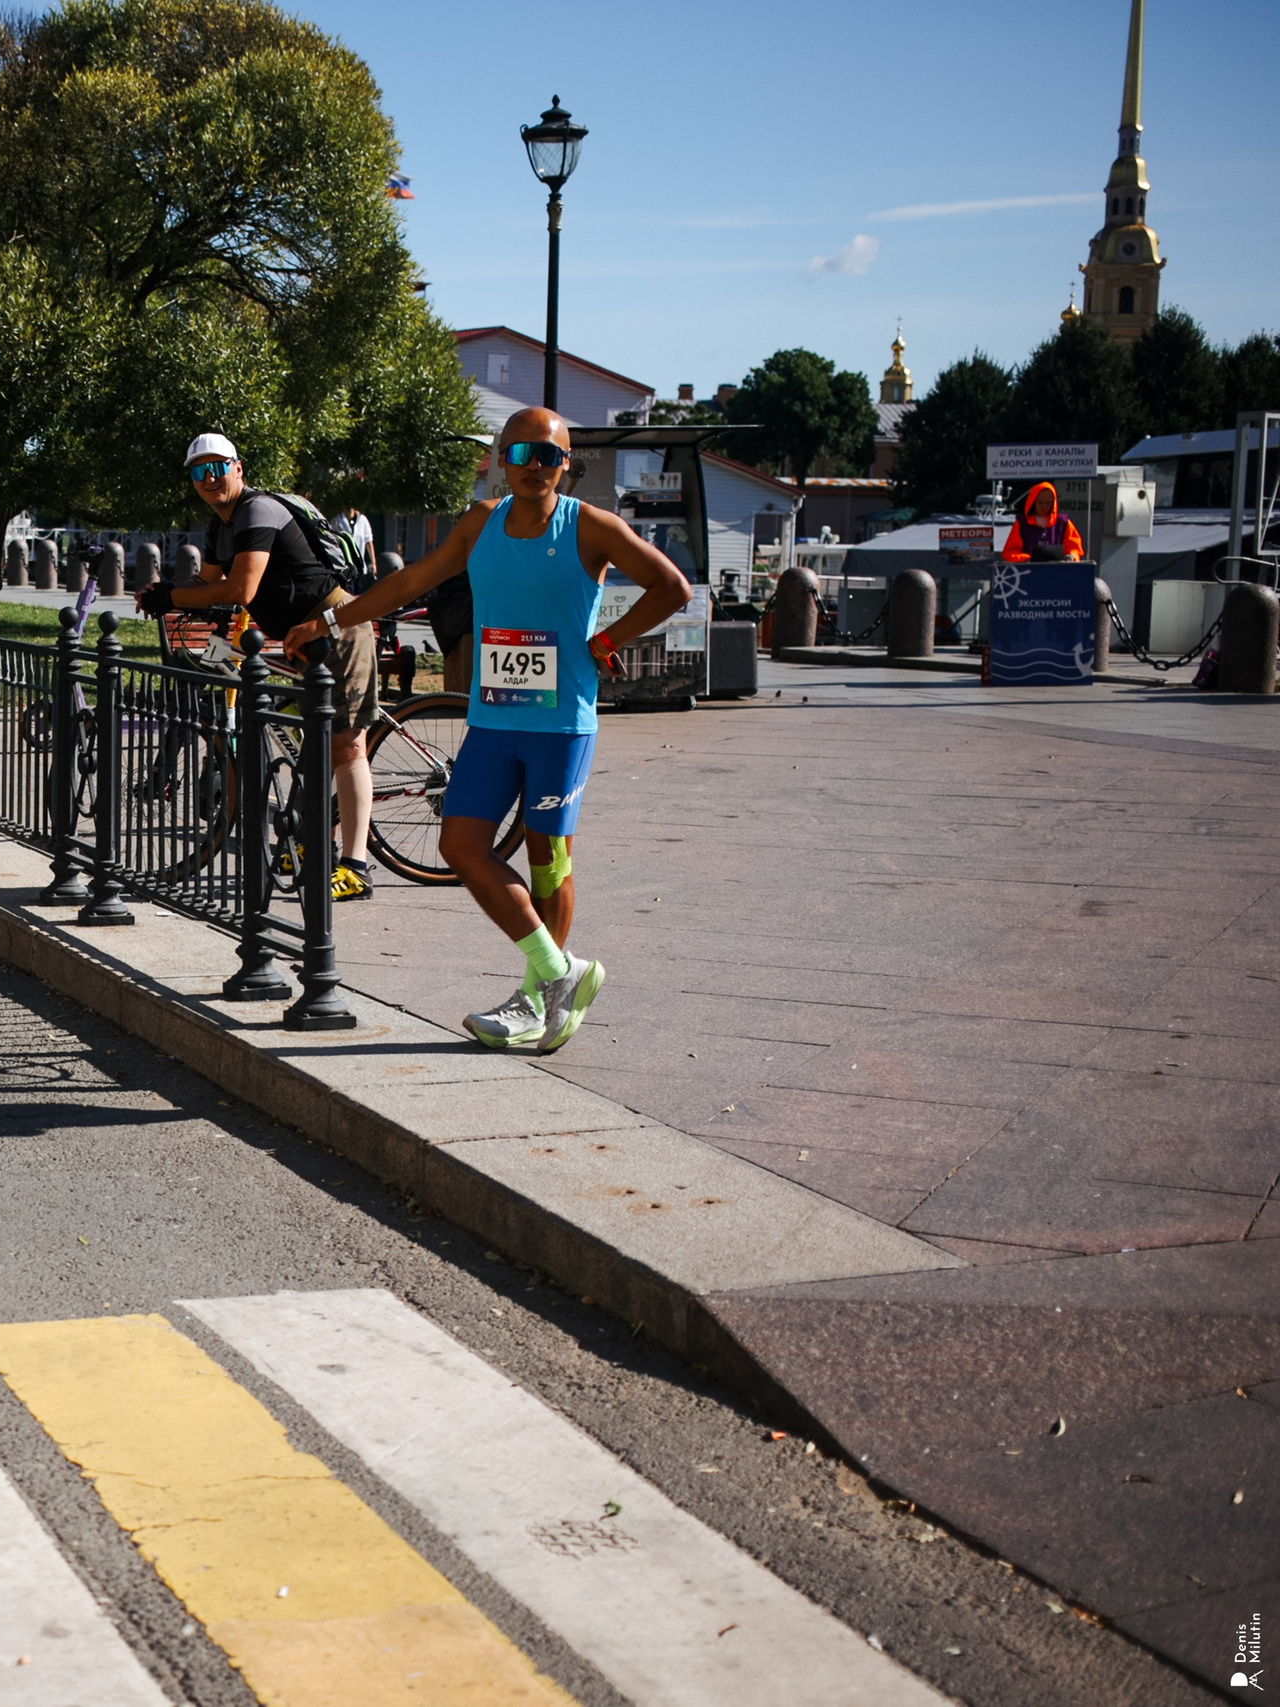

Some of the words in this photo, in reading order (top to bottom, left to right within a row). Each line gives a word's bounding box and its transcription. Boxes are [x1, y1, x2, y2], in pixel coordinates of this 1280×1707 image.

[1008, 448, 1032, 457] РЕКИ
[1045, 447, 1085, 456] КАНАЛЫ
[1000, 459, 1044, 468] МОРСКИЕ
[1045, 458, 1094, 467] ПРОГУЛКИ
[940, 529, 992, 538] МЕТЕОРЫ
[1017, 599, 1072, 608] ЭКСКУРСИИ
[998, 611, 1055, 620] РАЗВОДНЫЕ
[1056, 610, 1091, 619] МОСТЫ
[489, 650, 547, 676] 1495
[502, 677, 529, 685] АЛДАР
